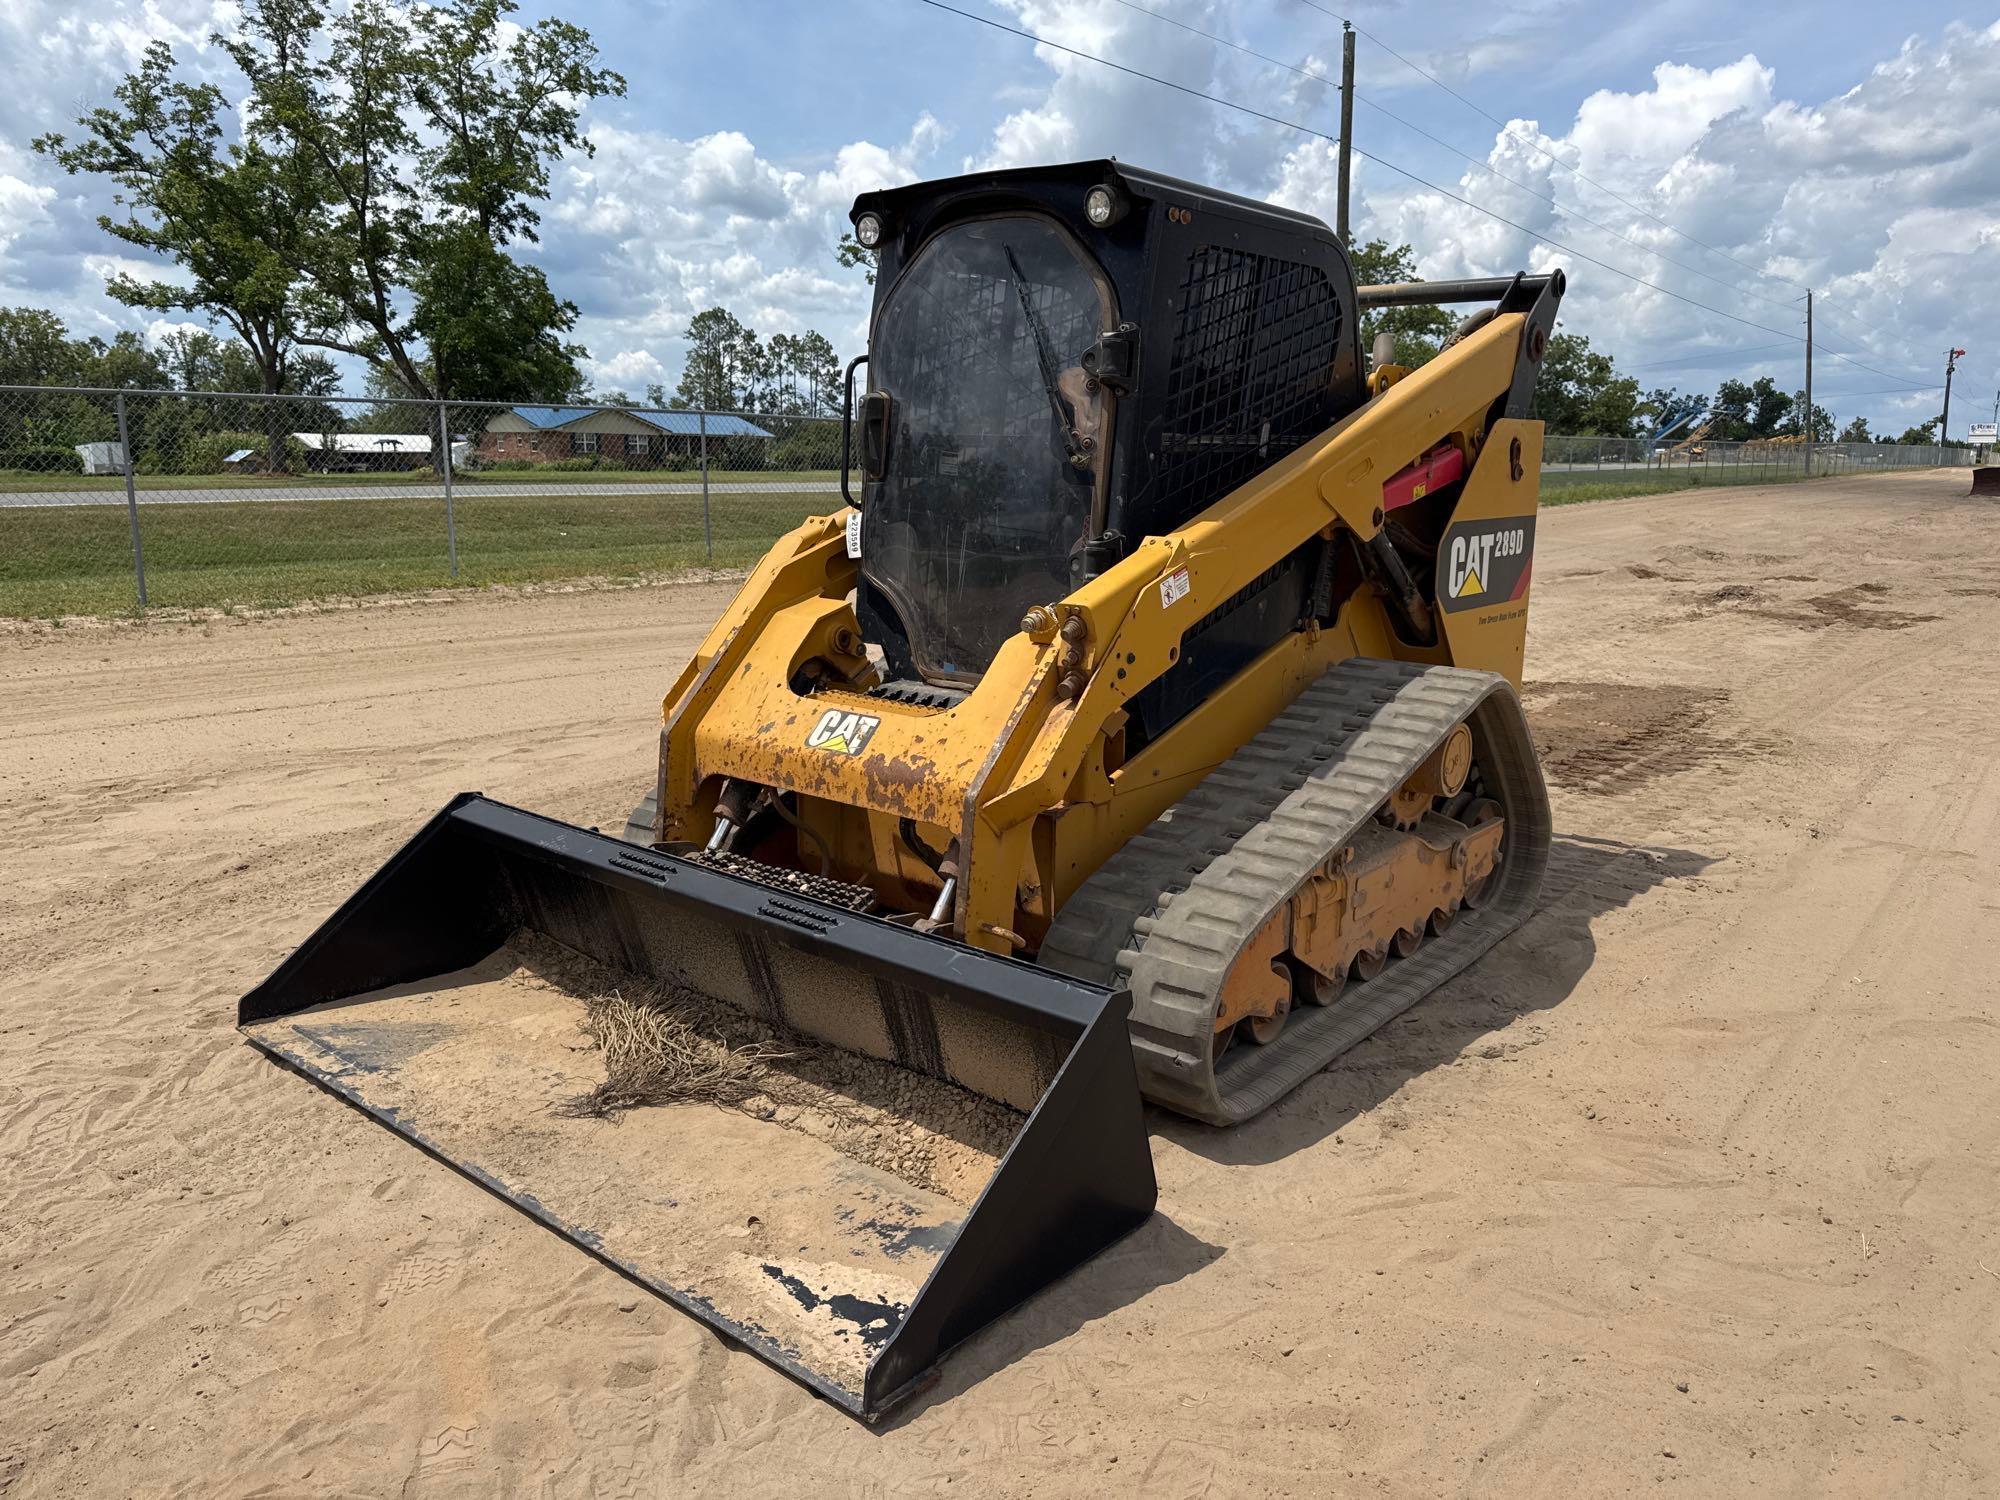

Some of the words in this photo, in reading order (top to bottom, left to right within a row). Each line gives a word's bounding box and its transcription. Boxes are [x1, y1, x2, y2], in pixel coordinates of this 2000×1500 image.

[851, 521, 859, 552] 223569
[1449, 534, 1494, 599] CAT
[1494, 529, 1524, 557] 289D
[808, 710, 880, 755] CAT
